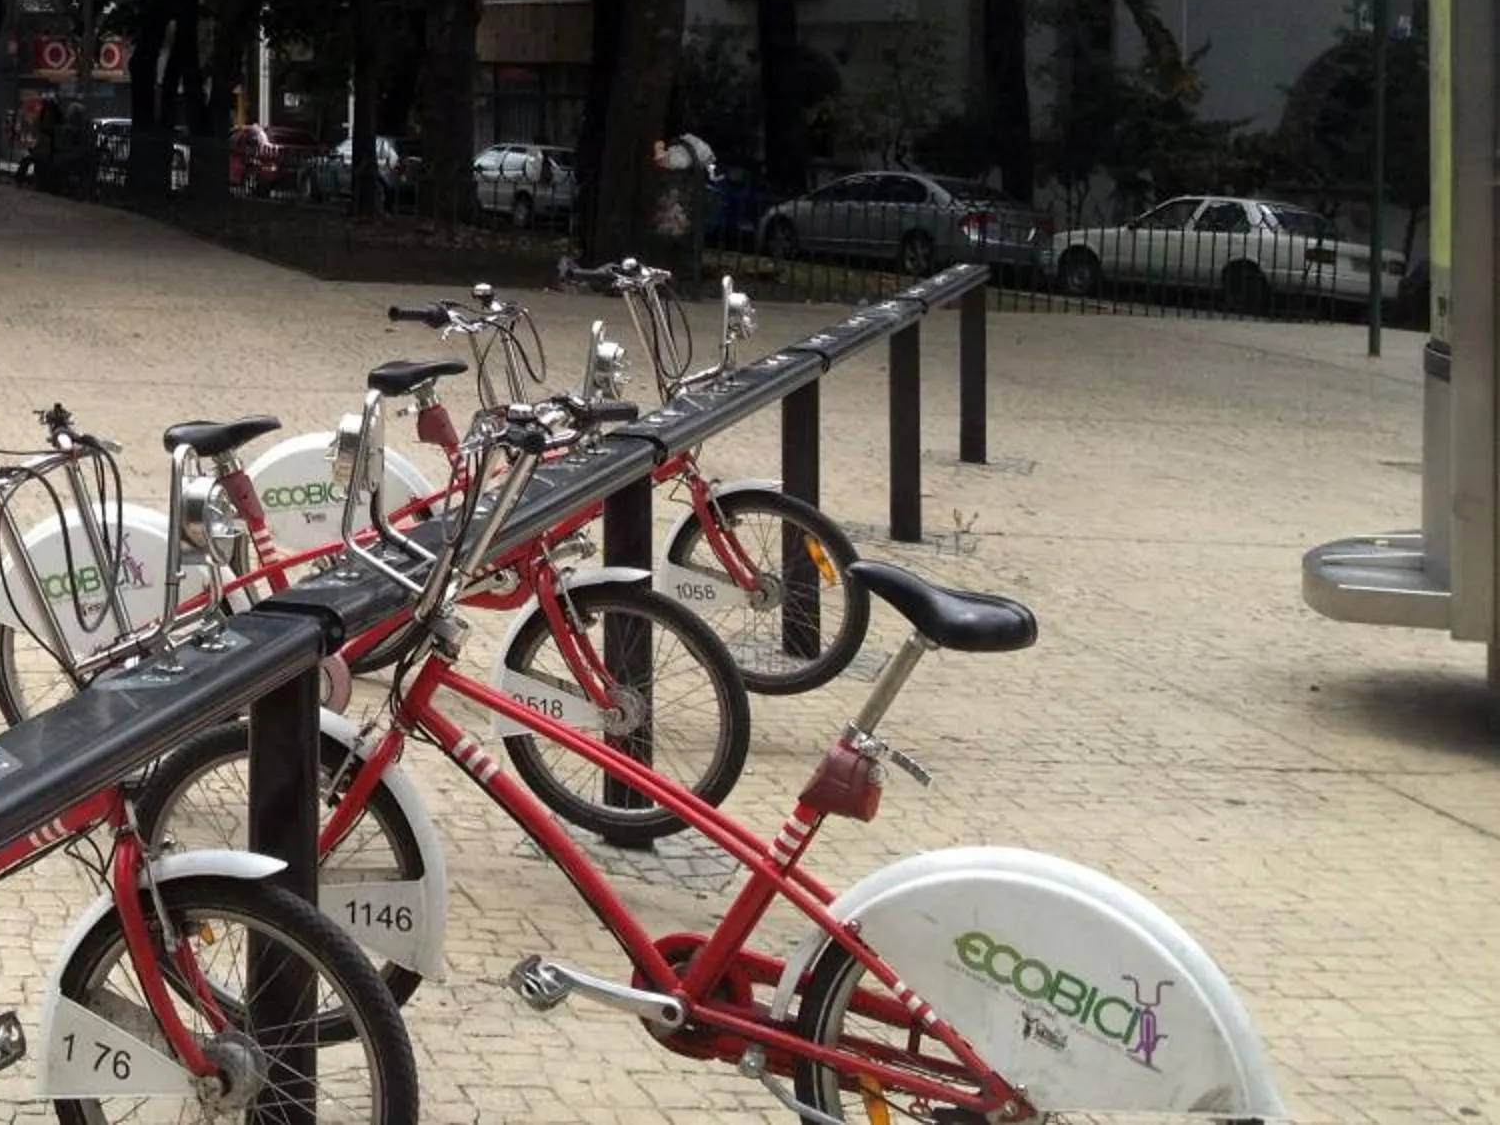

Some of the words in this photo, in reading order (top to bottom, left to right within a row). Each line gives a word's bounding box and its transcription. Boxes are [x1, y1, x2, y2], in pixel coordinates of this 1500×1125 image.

[262, 480, 350, 508] ECOBIC
[675, 581, 717, 601] 1058
[345, 900, 414, 933] 1146
